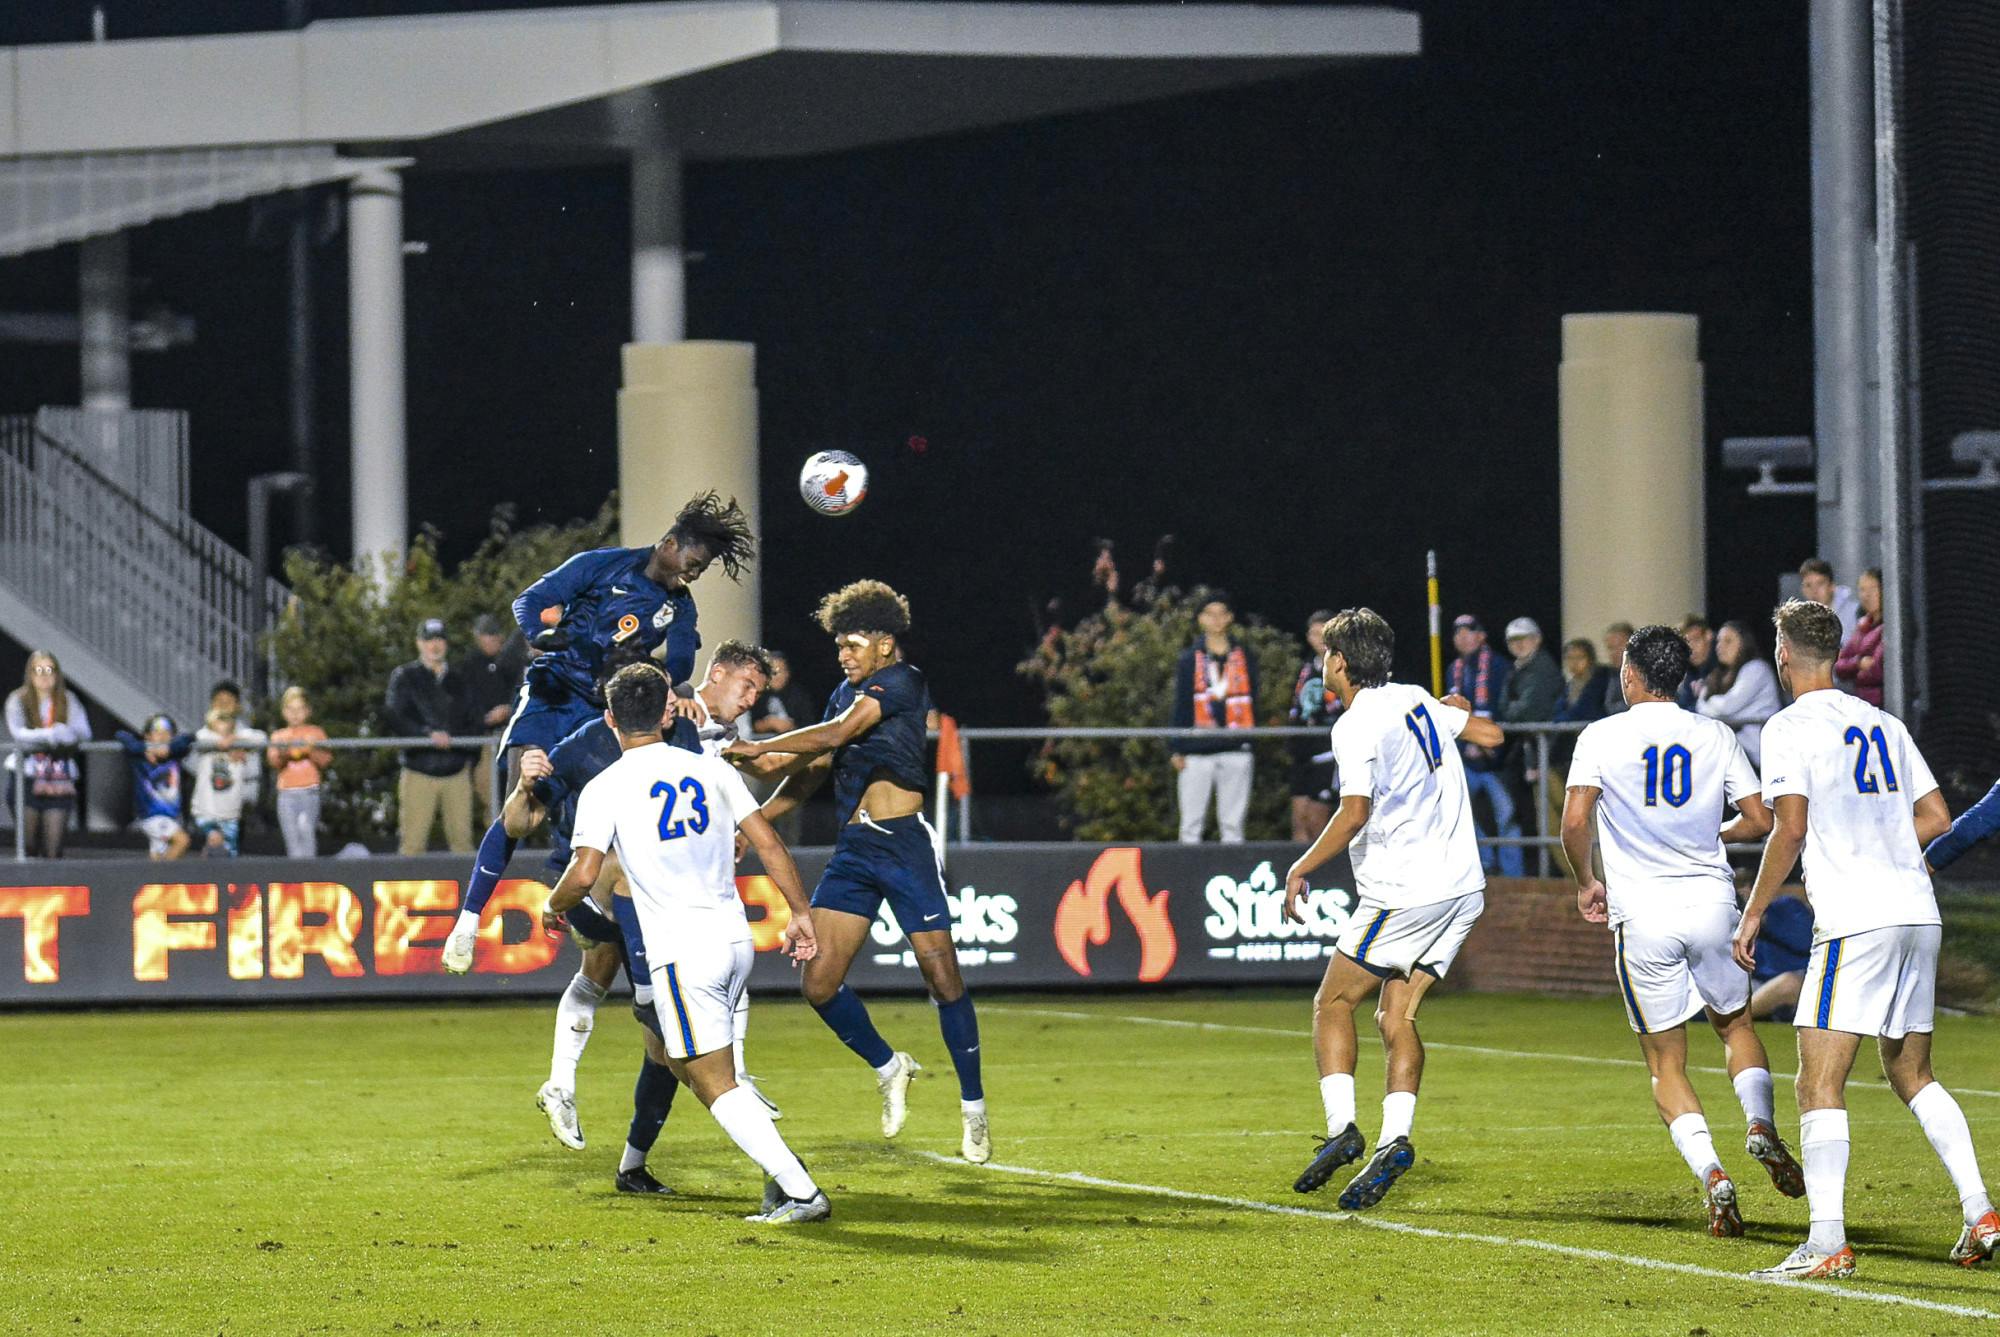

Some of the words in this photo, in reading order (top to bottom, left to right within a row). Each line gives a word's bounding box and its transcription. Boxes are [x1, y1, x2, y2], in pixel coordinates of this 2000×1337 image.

[612, 614, 639, 642] 9
[1405, 702, 1442, 774] 17
[1844, 725, 1898, 794] 21
[650, 776, 710, 841] 23
[1642, 744, 1691, 808] 10
[133, 879, 561, 982] FIRED
